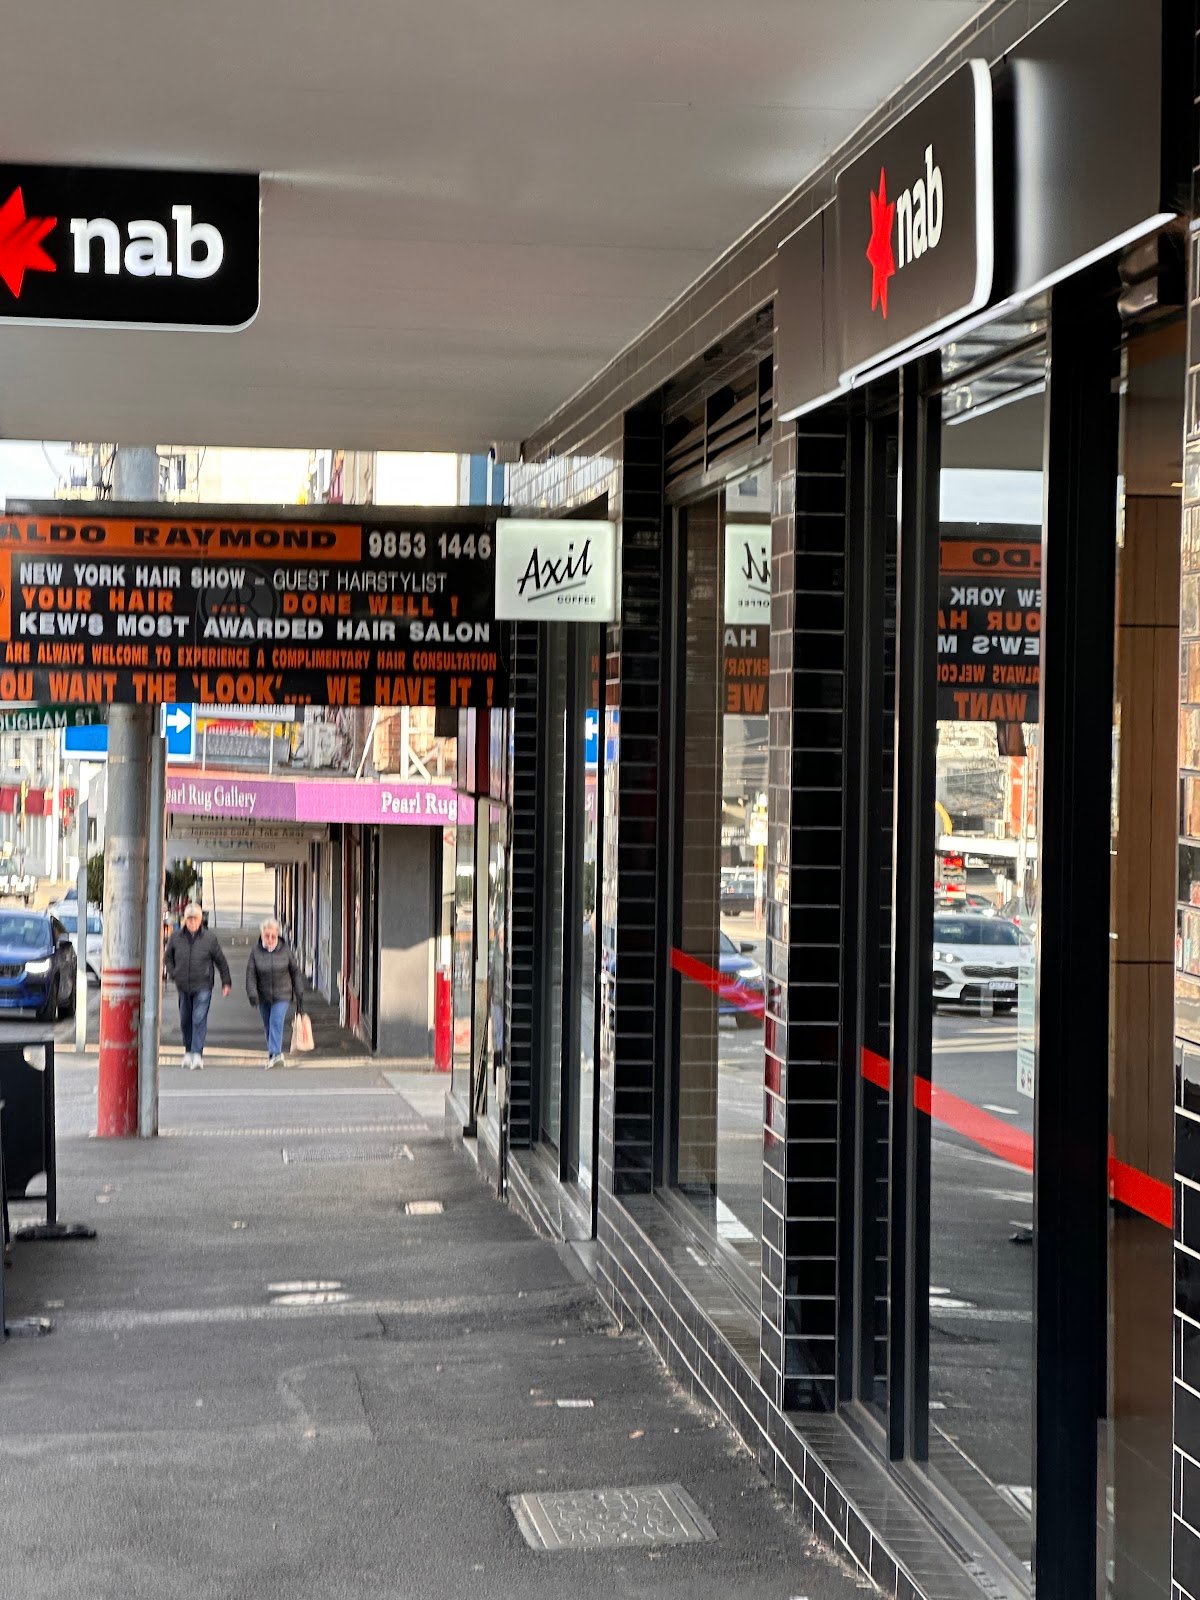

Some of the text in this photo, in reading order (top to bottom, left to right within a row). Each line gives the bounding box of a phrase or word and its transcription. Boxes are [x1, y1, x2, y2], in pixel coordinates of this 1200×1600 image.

[897, 143, 944, 269] nab
[69, 204, 224, 279] nab
[0, 521, 337, 548] ALDO RAYMOND
[368, 530, 492, 560] 9853 1446
[20, 563, 63, 586] NEW
[74, 564, 126, 587] YORK
[136, 565, 181, 588] HAIR
[190, 566, 246, 590] SHOW
[273, 568, 331, 591] GUEST
[337, 571, 448, 593] HAIRSTYLIST
[517, 538, 593, 596] Axil
[21, 585, 92, 611] YOUR
[109, 587, 174, 613] HAIR
[283, 593, 352, 616] DONE
[369, 595, 434, 617] WELL
[557, 596, 596, 605] COFFEE
[19, 611, 490, 642] KEW'S MOST AWARDED HAIR SALON
[5, 641, 497, 672] ARE ALWAYS WELCOME TO EXPERIENCE A COMPLIMENTARY HAIR CONSULTATION
[49, 671, 118, 704] WANT
[132, 672, 177, 704] THE
[327, 674, 361, 705] WE
[375, 676, 436, 706] HAVE
[451, 677, 472, 707] IT
[486, 678, 495, 707] !
[189, 783, 212, 812] Rug
[214, 784, 257, 814] Gallery
[381, 791, 457, 821] Pearl Rug
